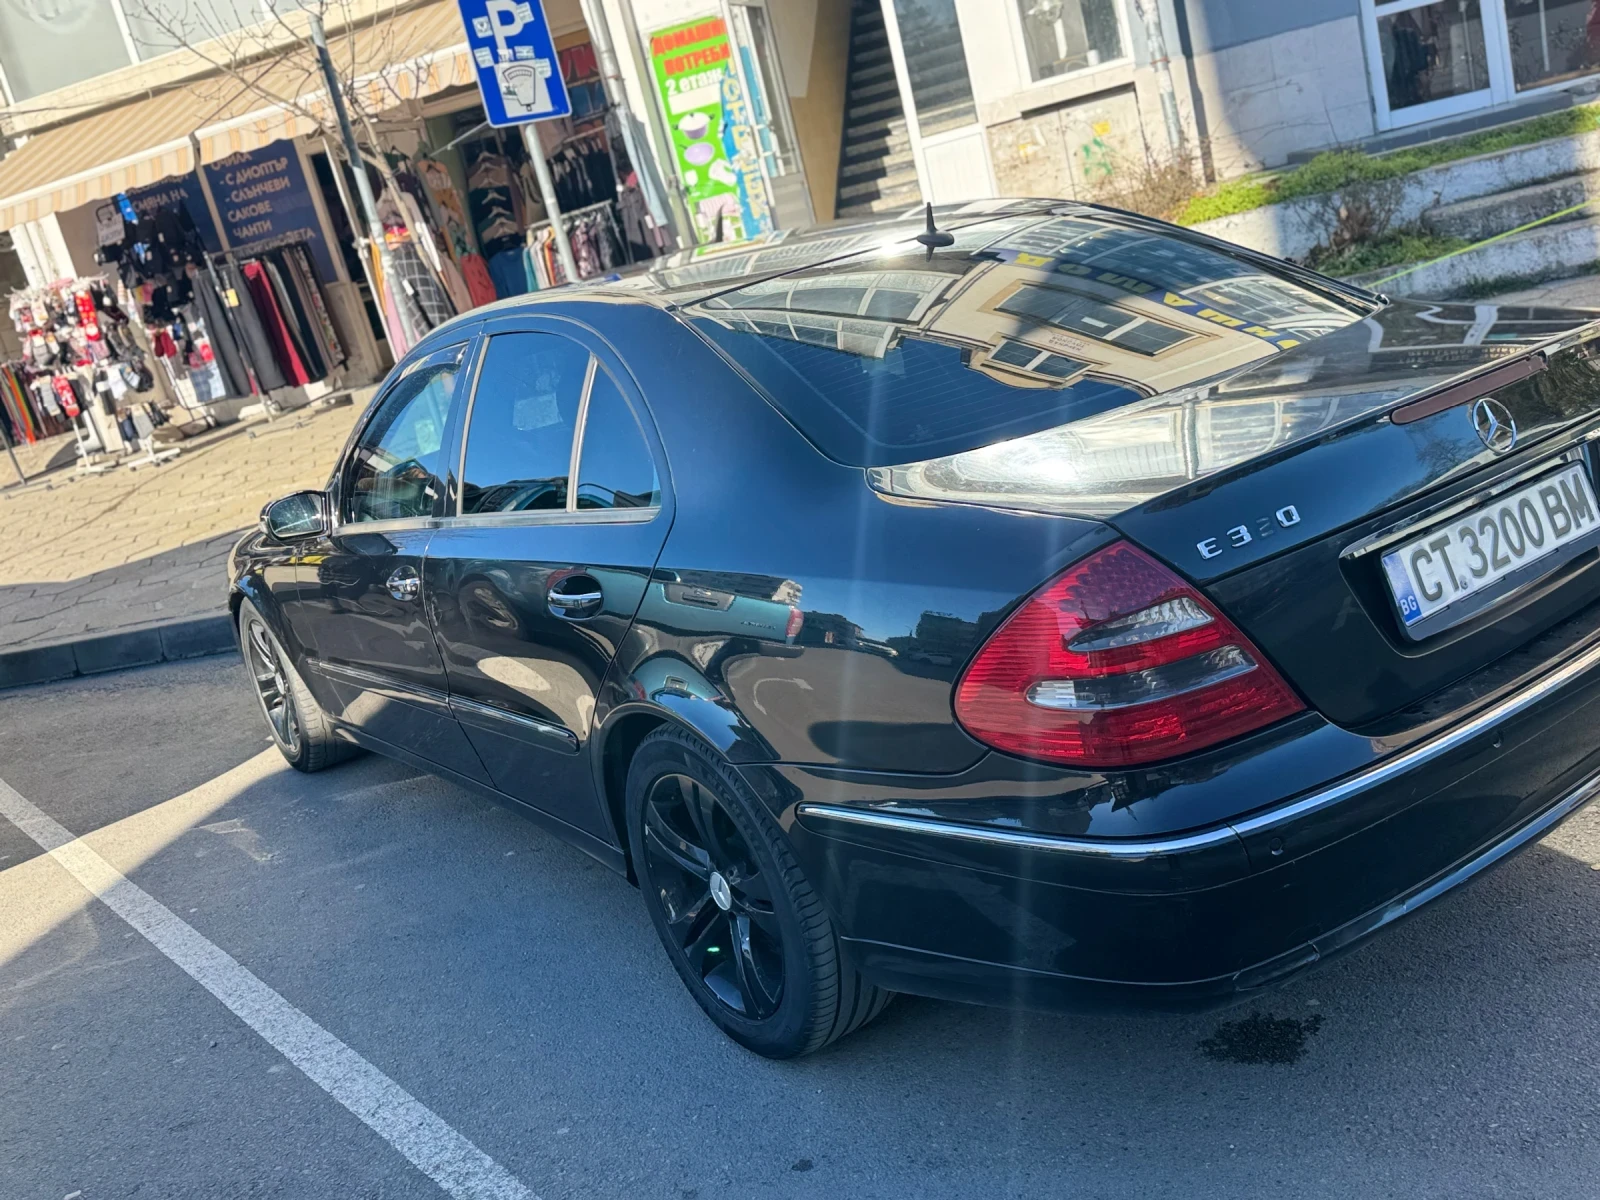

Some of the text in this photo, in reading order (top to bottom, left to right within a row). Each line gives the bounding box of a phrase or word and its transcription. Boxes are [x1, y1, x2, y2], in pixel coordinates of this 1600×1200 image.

[485, 0, 525, 52] P
[663, 42, 730, 76] ПОТРЕБИ
[665, 79, 678, 96] 2
[236, 157, 288, 185] ДИОПТЪР
[227, 200, 273, 223] САКОВЕ
[233, 219, 273, 239] ЧАНТИ
[1411, 473, 1595, 602] CT 3200 BM
[1401, 594, 1419, 616] BG
